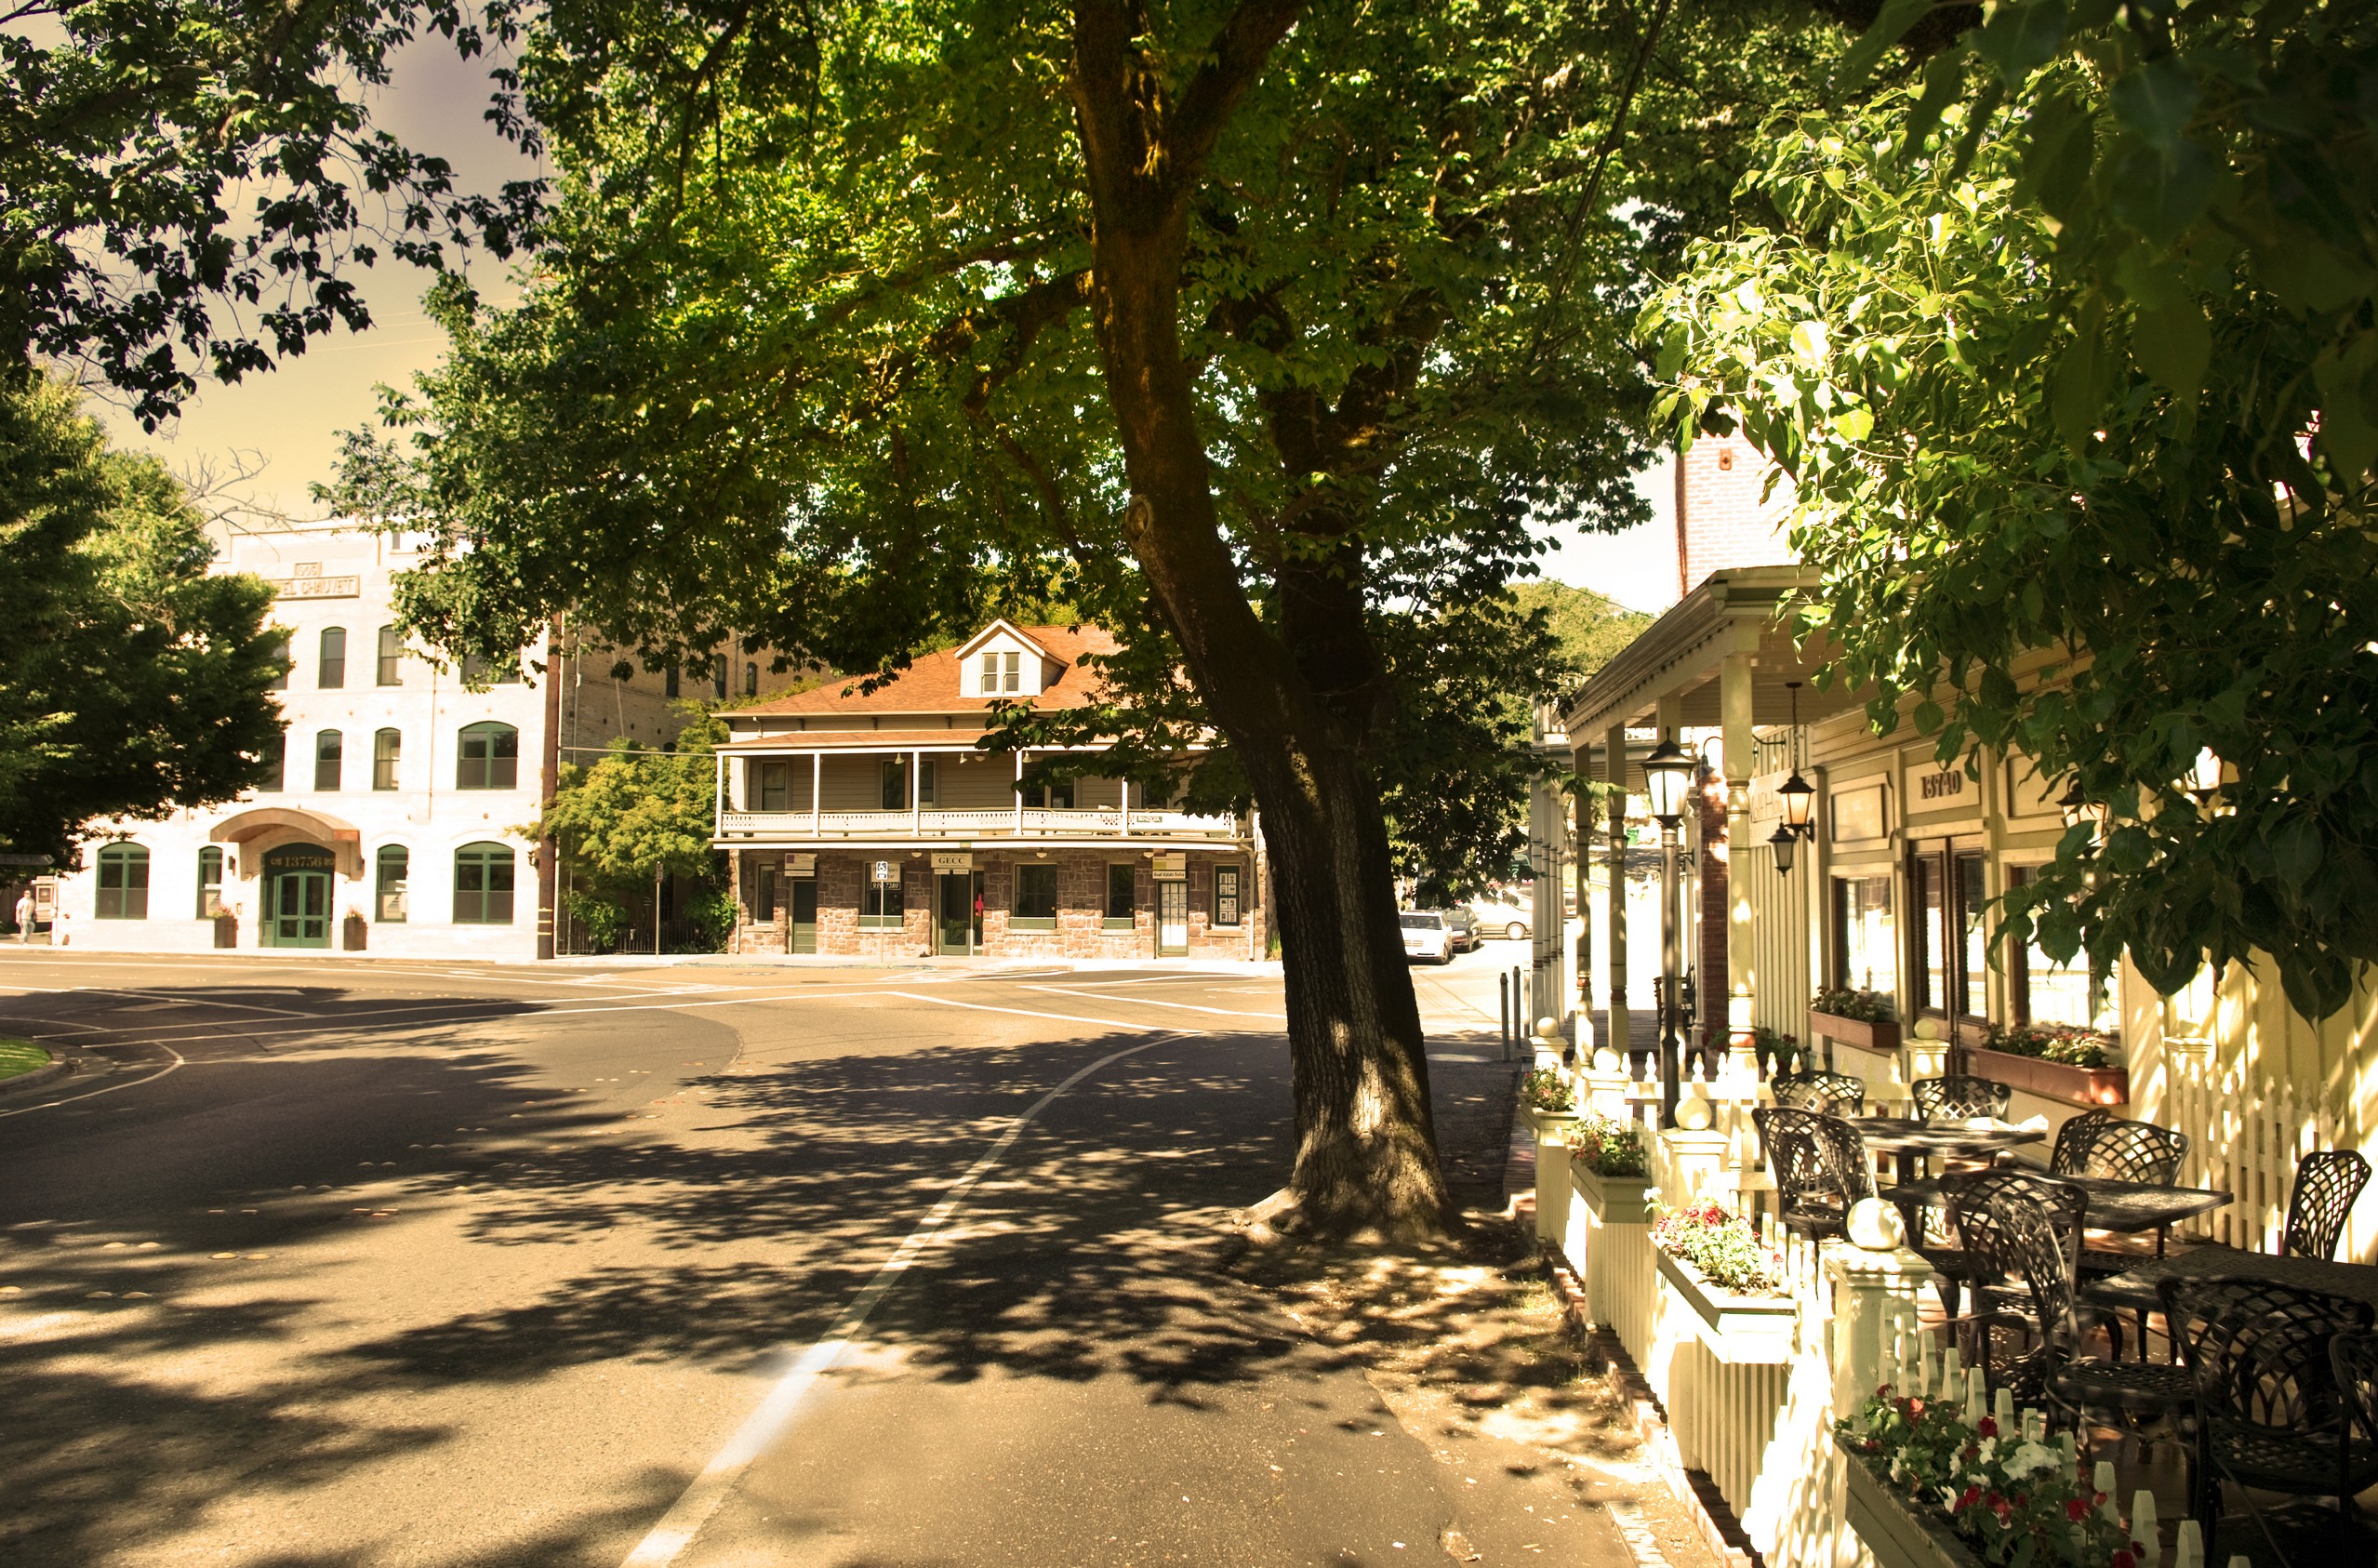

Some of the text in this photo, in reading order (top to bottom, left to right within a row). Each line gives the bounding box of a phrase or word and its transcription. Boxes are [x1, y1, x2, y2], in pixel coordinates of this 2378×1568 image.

[301, 578, 354, 595] CHAUVET
[1920, 770, 1962, 800] 13740
[286, 856, 322, 868] 13756
[938, 857, 965, 865] GECC
